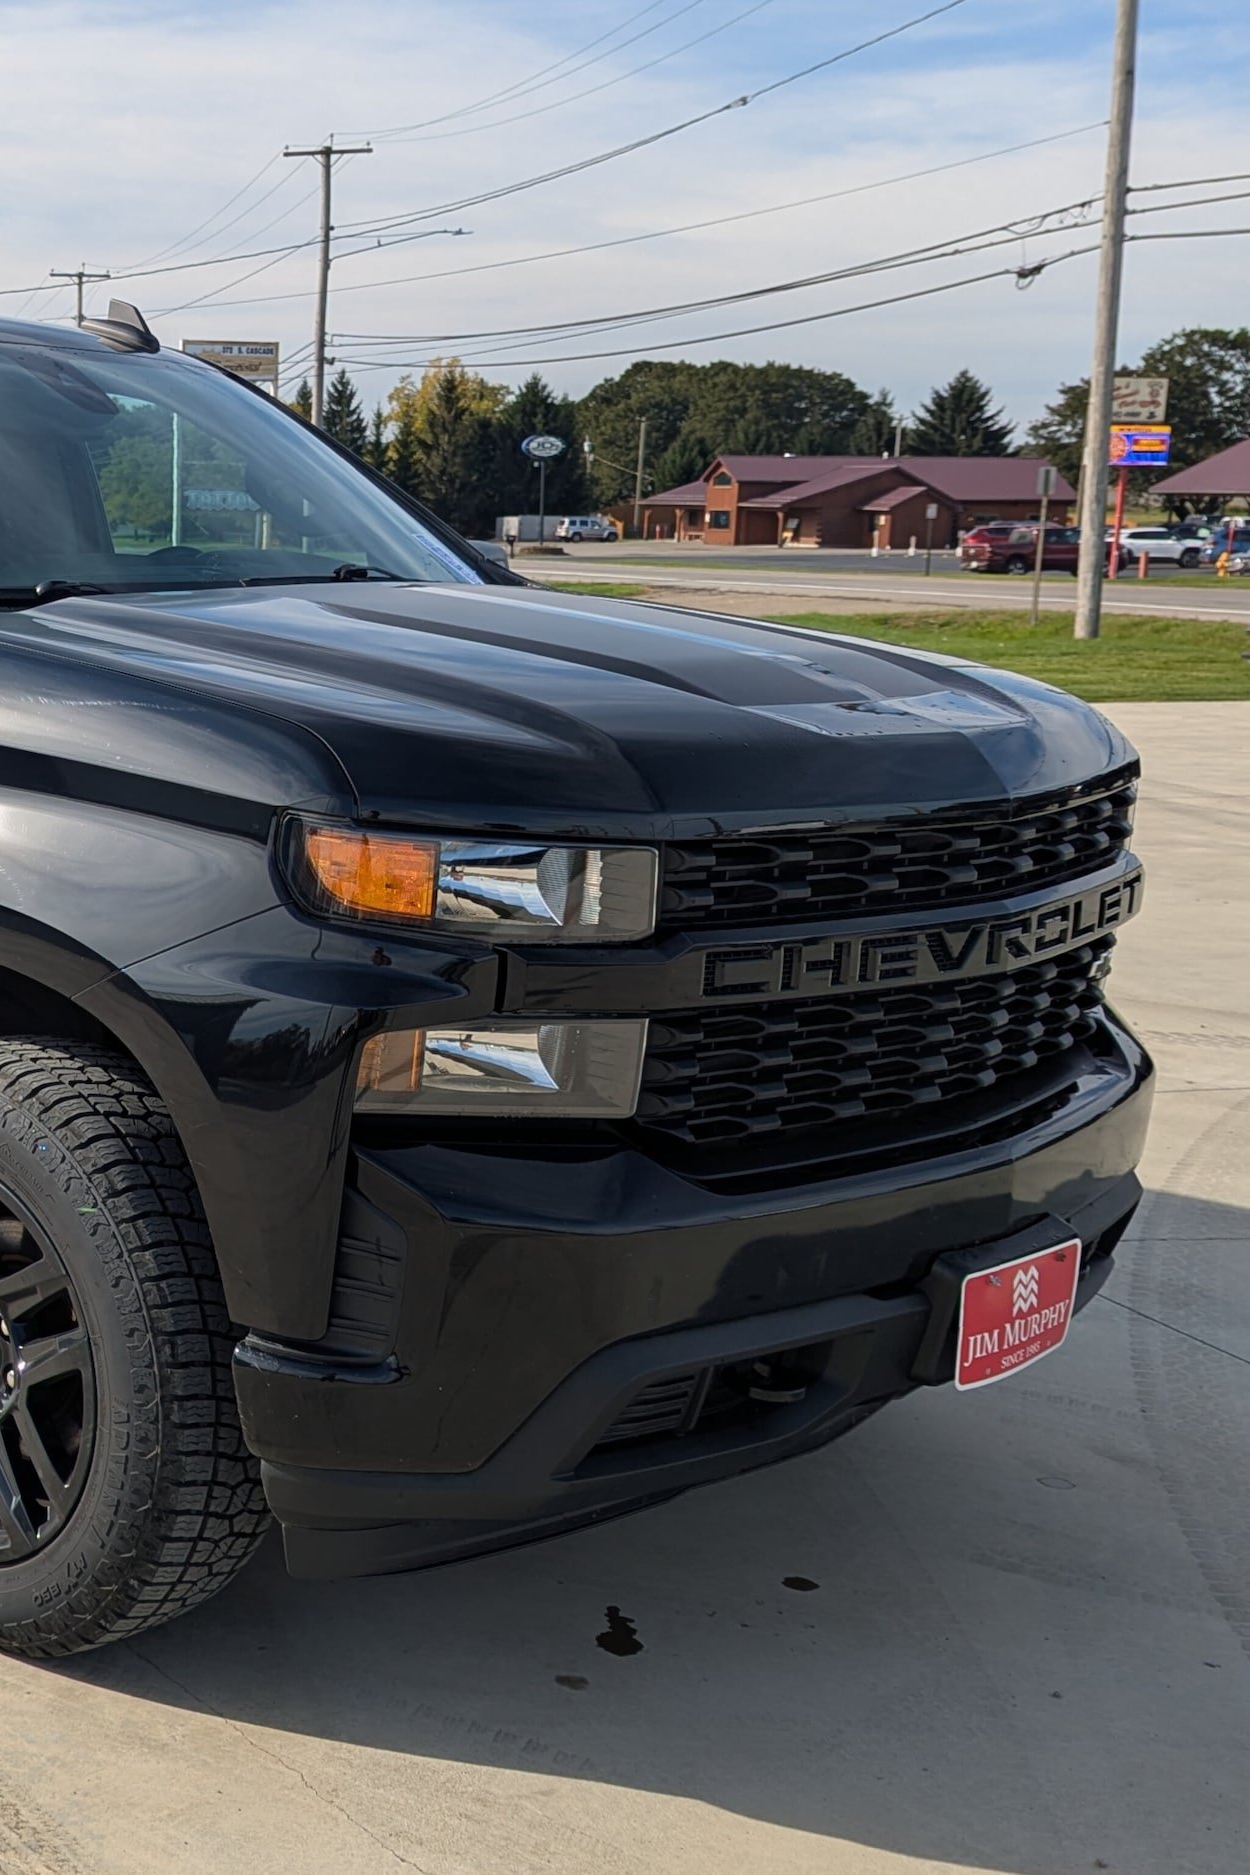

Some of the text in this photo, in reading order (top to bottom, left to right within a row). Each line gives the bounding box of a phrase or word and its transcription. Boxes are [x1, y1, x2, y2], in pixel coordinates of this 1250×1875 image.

[245, 346, 275, 356] CASCADE
[701, 874, 1142, 997] CHEVROLET
[963, 1299, 1070, 1367] JIM MURPHY
[1000, 1348, 1025, 1369] SINCE
